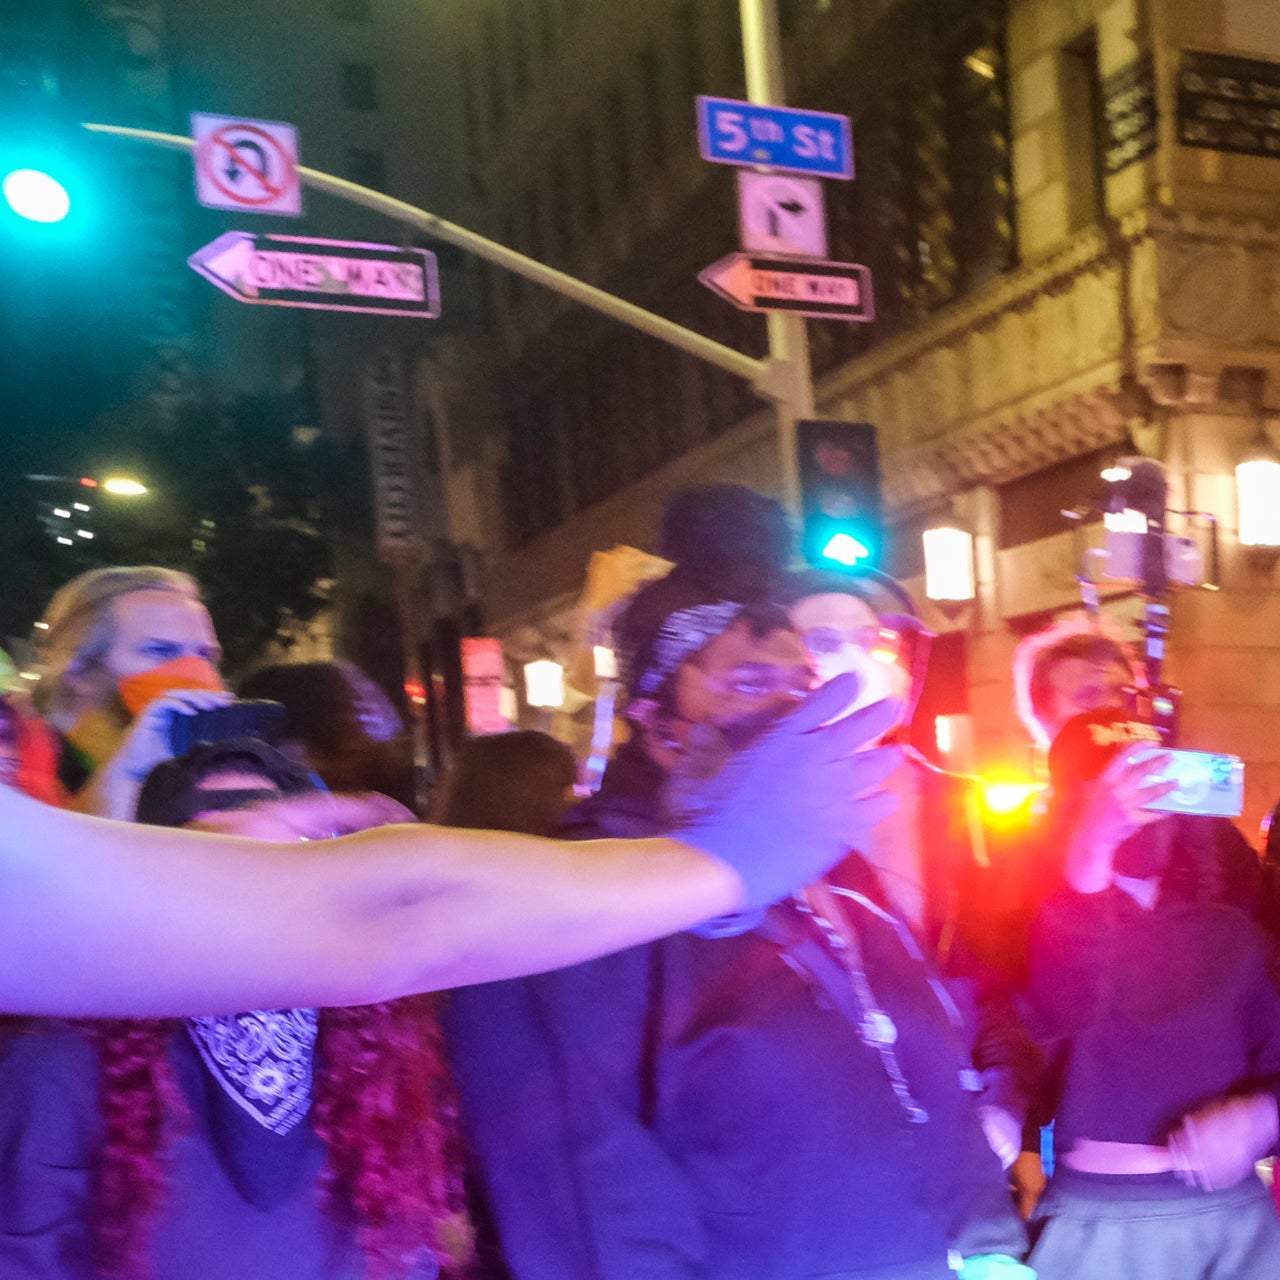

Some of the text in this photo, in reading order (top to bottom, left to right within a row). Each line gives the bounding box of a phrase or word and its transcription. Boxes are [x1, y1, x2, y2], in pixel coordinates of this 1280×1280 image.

[715, 110, 837, 161] 5th St
[256, 254, 319, 287] ONE
